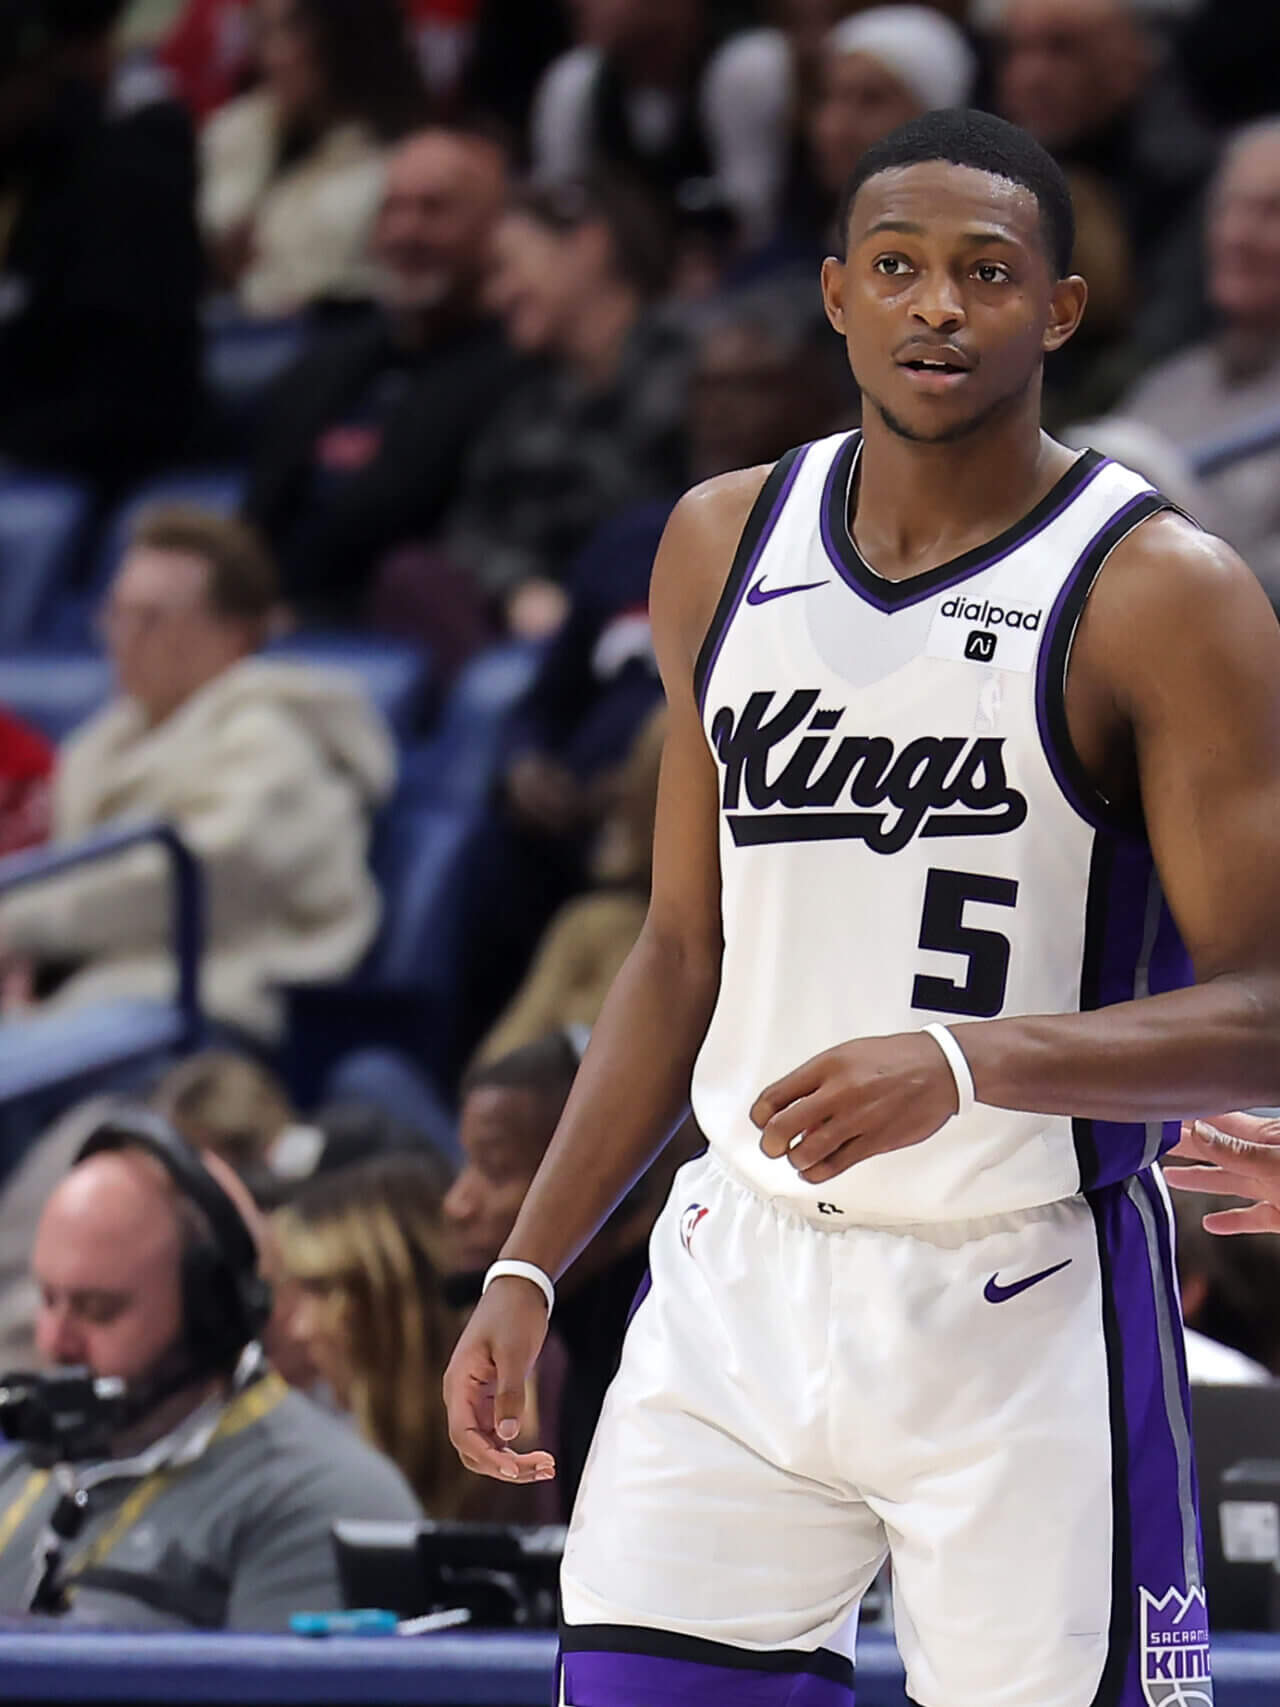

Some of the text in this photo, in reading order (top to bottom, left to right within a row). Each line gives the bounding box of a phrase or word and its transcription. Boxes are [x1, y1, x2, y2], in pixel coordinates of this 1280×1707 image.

[941, 597, 1042, 631] dialpad
[711, 689, 1028, 855] Kings
[911, 867, 1019, 1018] 5
